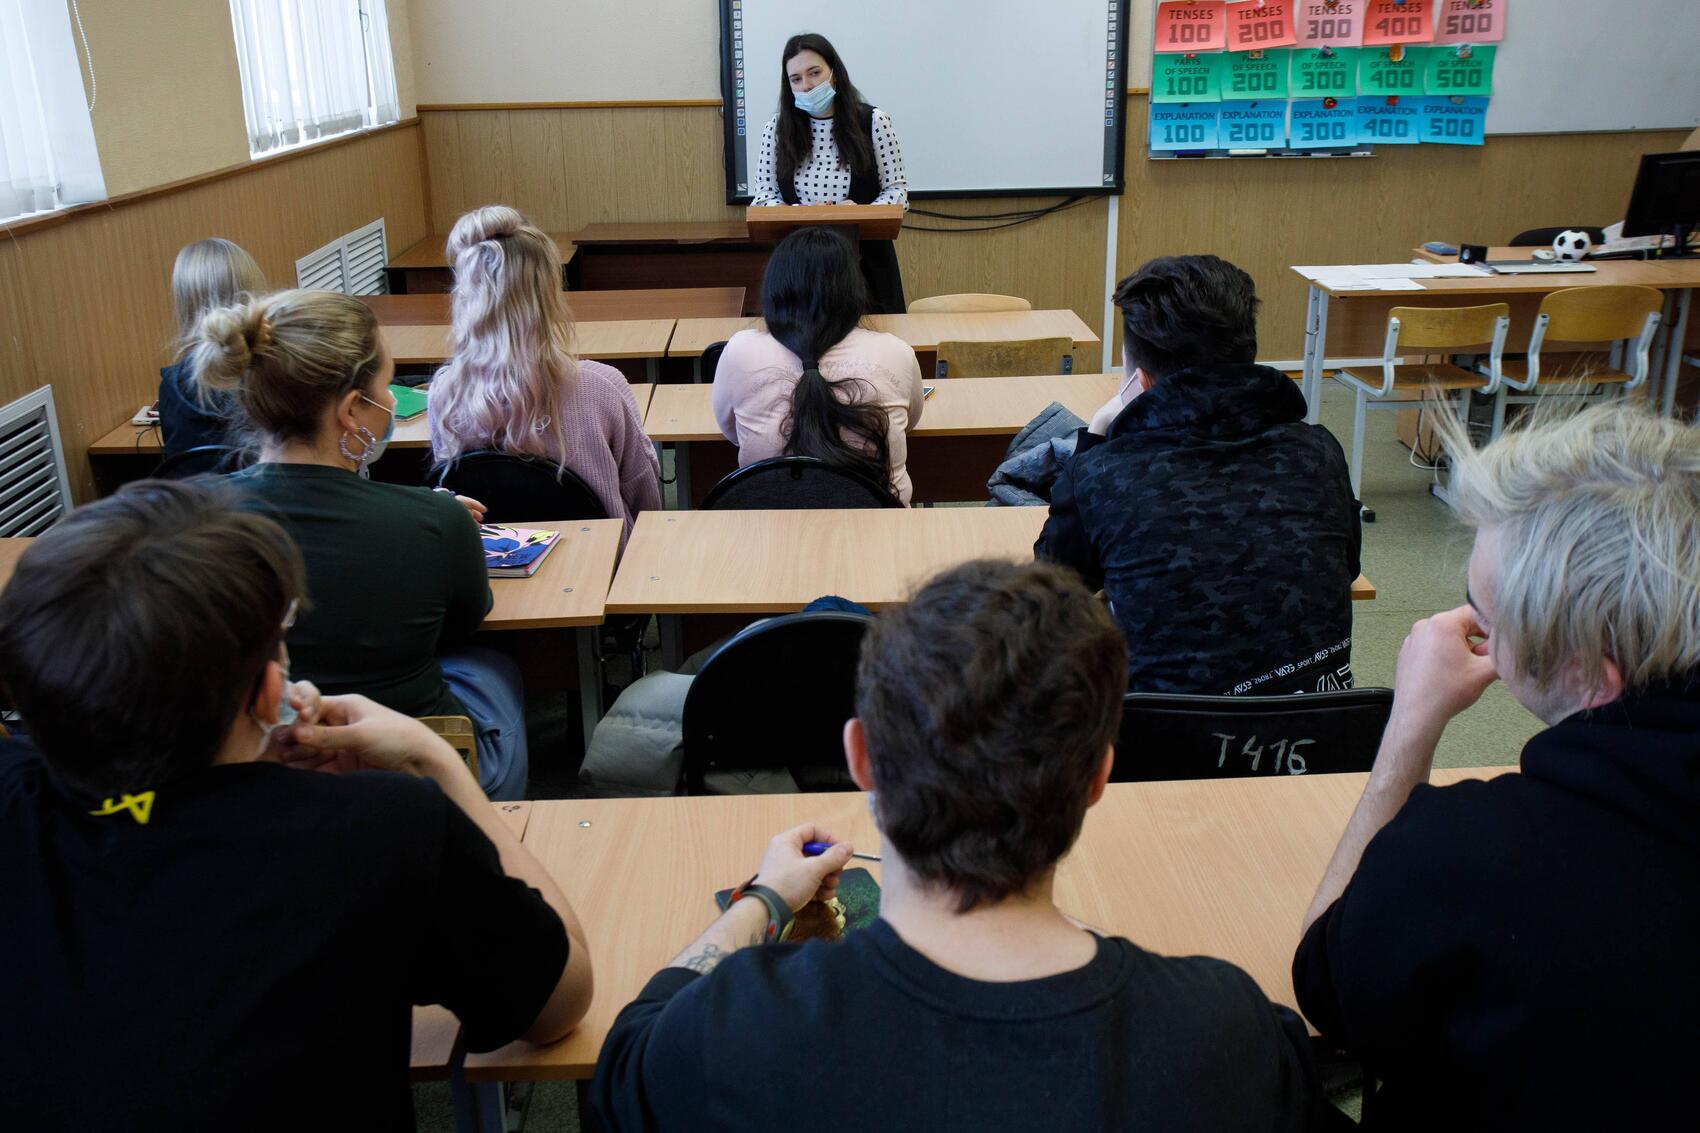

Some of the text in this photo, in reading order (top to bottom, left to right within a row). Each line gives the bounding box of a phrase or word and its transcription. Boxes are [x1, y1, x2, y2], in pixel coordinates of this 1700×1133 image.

[1169, 9, 1214, 20] TENSES
[1238, 5, 1283, 20] TENSES
[1308, 4, 1352, 15] TENSES
[1378, 3, 1423, 13] TENSES
[1168, 23, 1211, 43] 100
[1238, 20, 1284, 43] 200
[1306, 19, 1352, 39] 300
[1375, 16, 1422, 36] 400
[1446, 13, 1492, 35] 500
[1174, 57, 1201, 66] PARTS
[1232, 63, 1277, 72] OF SPEECH
[1314, 61, 1346, 69] SPEECH
[1382, 60, 1415, 68] SPEECH
[1164, 67, 1210, 76] OF SPEECH
[1302, 70, 1346, 90] 300
[1369, 69, 1414, 88] 400
[1437, 69, 1482, 88] 500
[1166, 76, 1208, 95] 100
[1232, 72, 1277, 92] 200
[1154, 112, 1215, 120] EXPLANATION
[1222, 110, 1282, 119] EXPLANATION
[1293, 109, 1354, 119] EXPLANATION
[1357, 105, 1418, 115] EXPLANATION
[1423, 105, 1485, 115] EXPLANATION
[1164, 124, 1205, 143] 100
[1229, 123, 1275, 142] 200
[1301, 122, 1346, 141] 300
[1363, 118, 1409, 137] 400
[1430, 118, 1474, 137] 500
